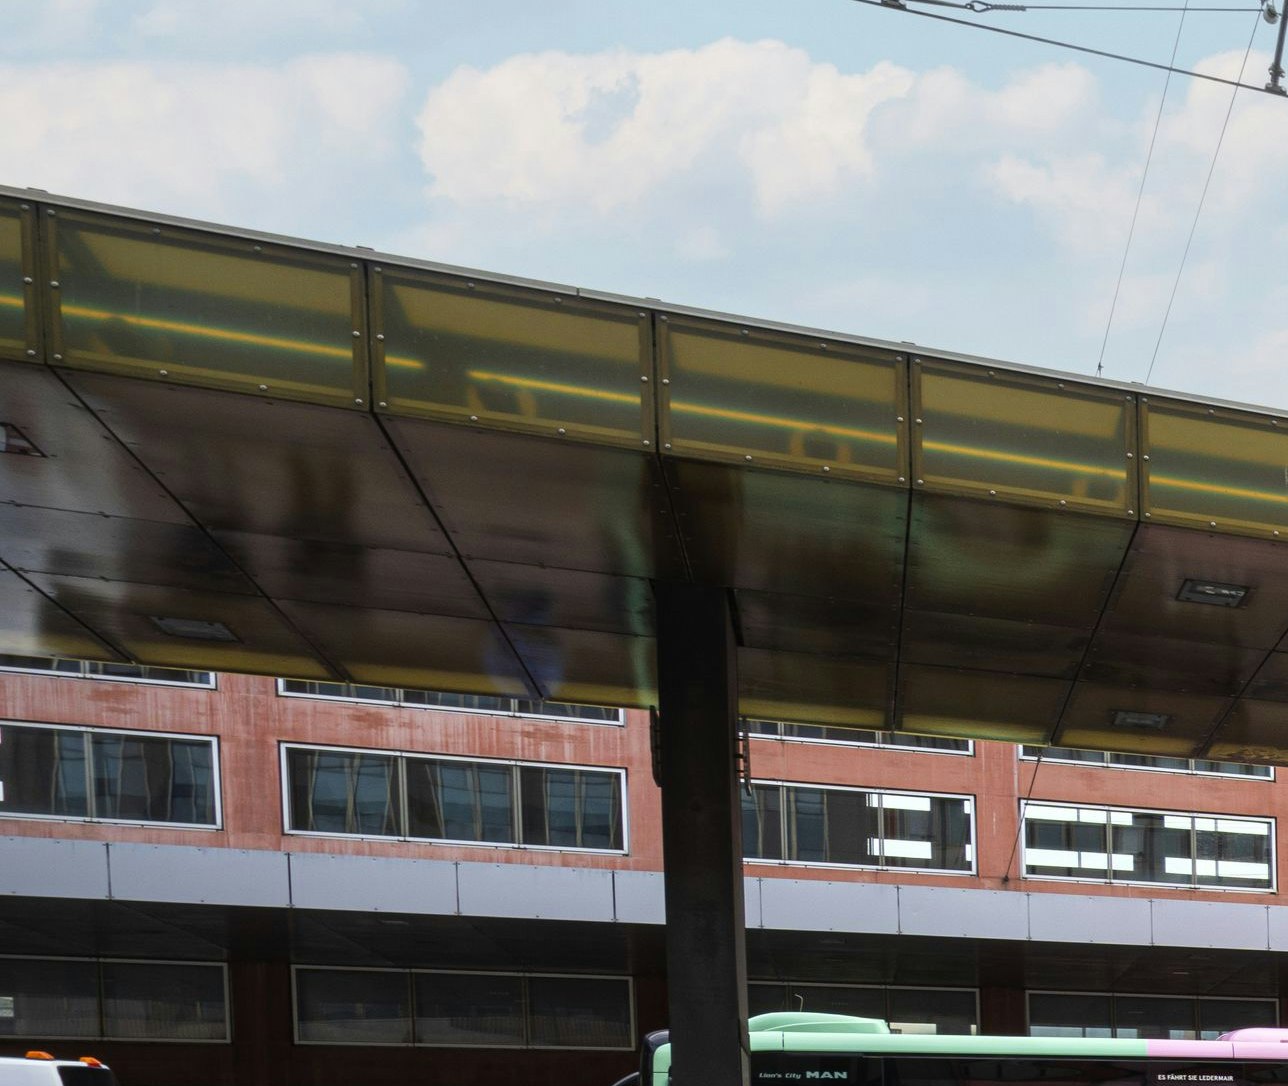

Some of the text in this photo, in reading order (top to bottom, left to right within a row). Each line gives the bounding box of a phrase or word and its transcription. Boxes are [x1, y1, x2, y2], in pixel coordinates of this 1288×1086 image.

[785, 1072, 801, 1080] City
[805, 1071, 848, 1079] MAN
[1167, 1073, 1187, 1081] FÄHRT
[1199, 1074, 1234, 1082] LEDERMAIR
